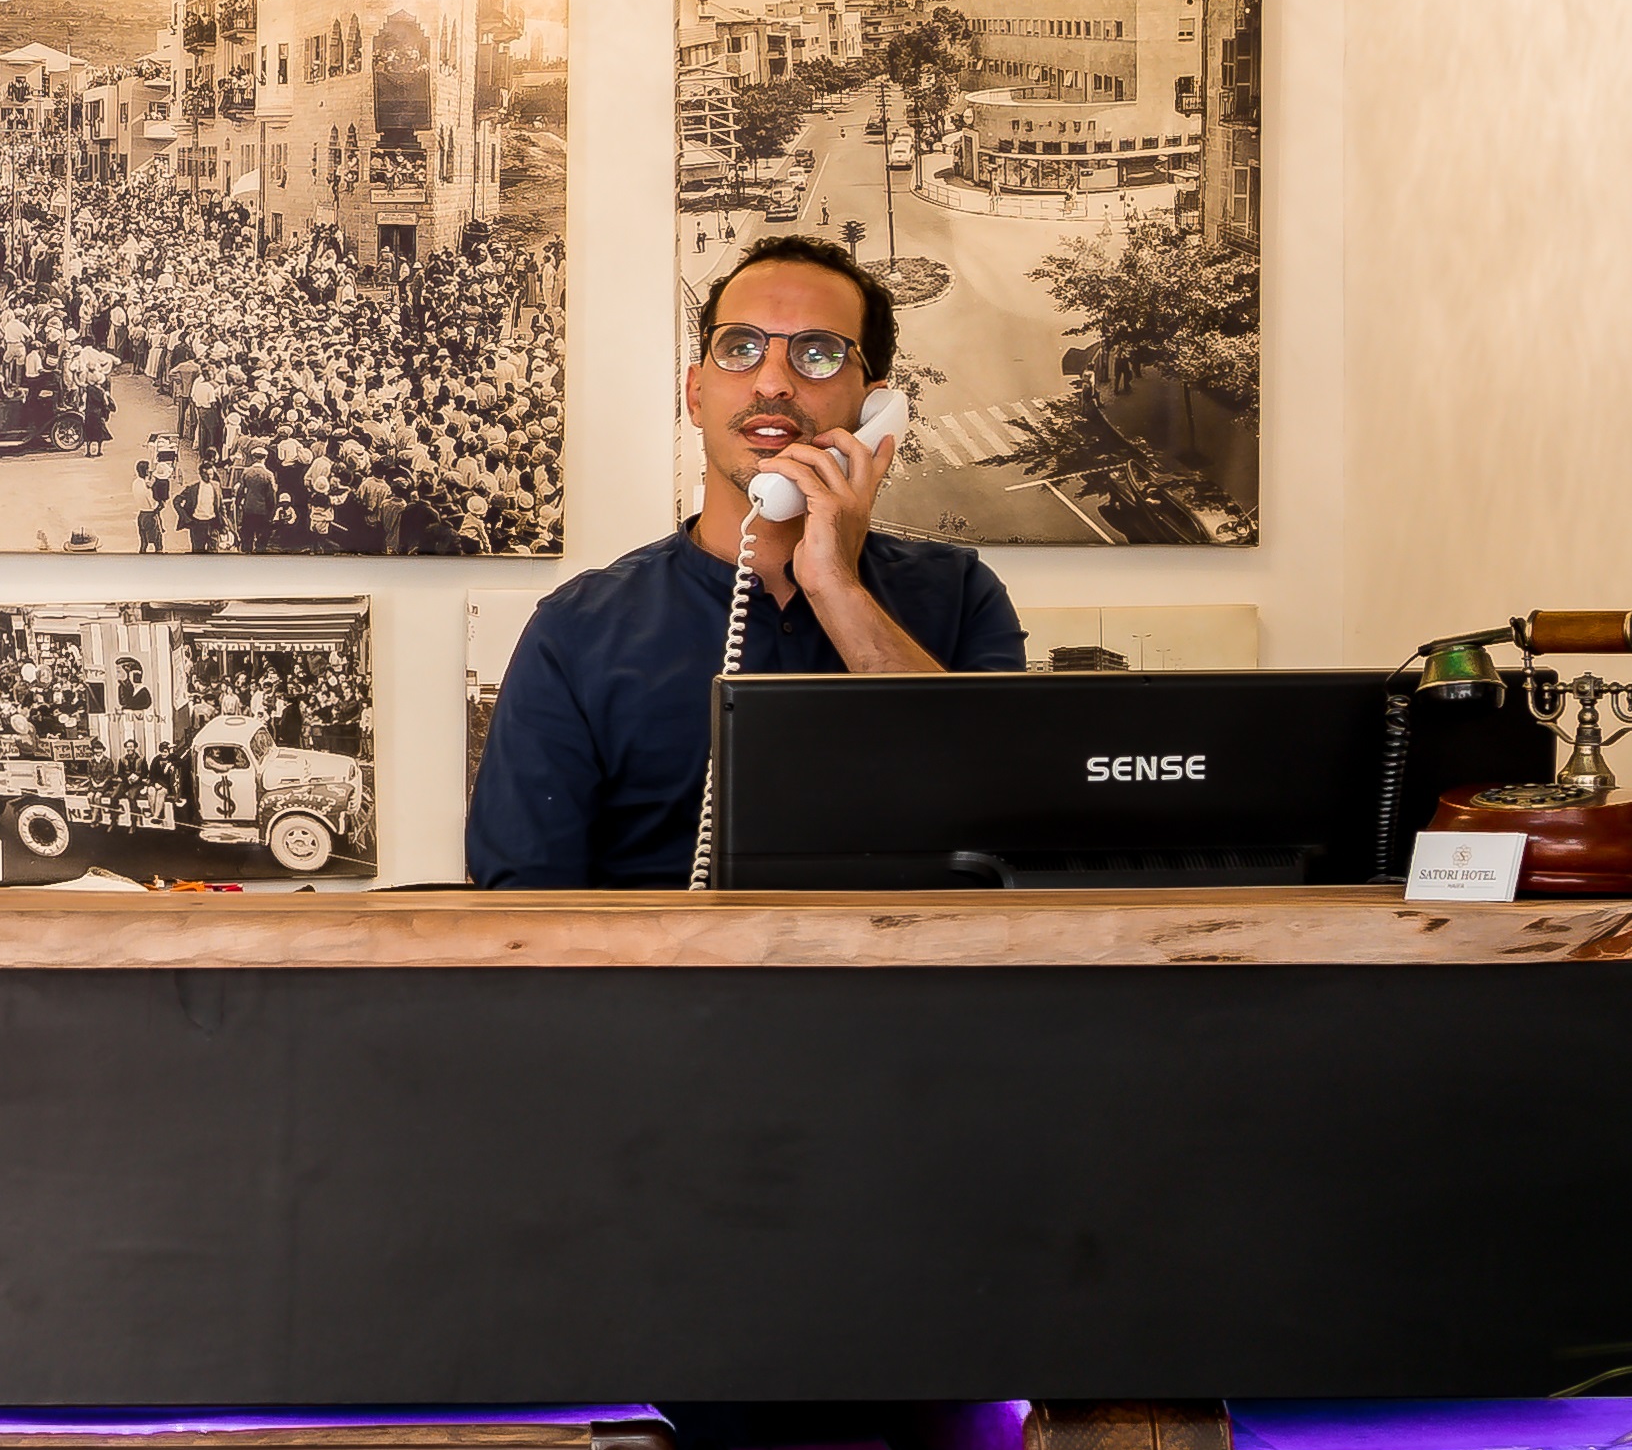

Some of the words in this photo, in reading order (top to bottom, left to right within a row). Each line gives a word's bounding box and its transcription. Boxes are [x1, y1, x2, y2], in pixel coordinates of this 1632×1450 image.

[1086, 755, 1206, 781] SENSE
[1418, 869, 1458, 882] SATORI
[1460, 870, 1497, 882] HOTEL
